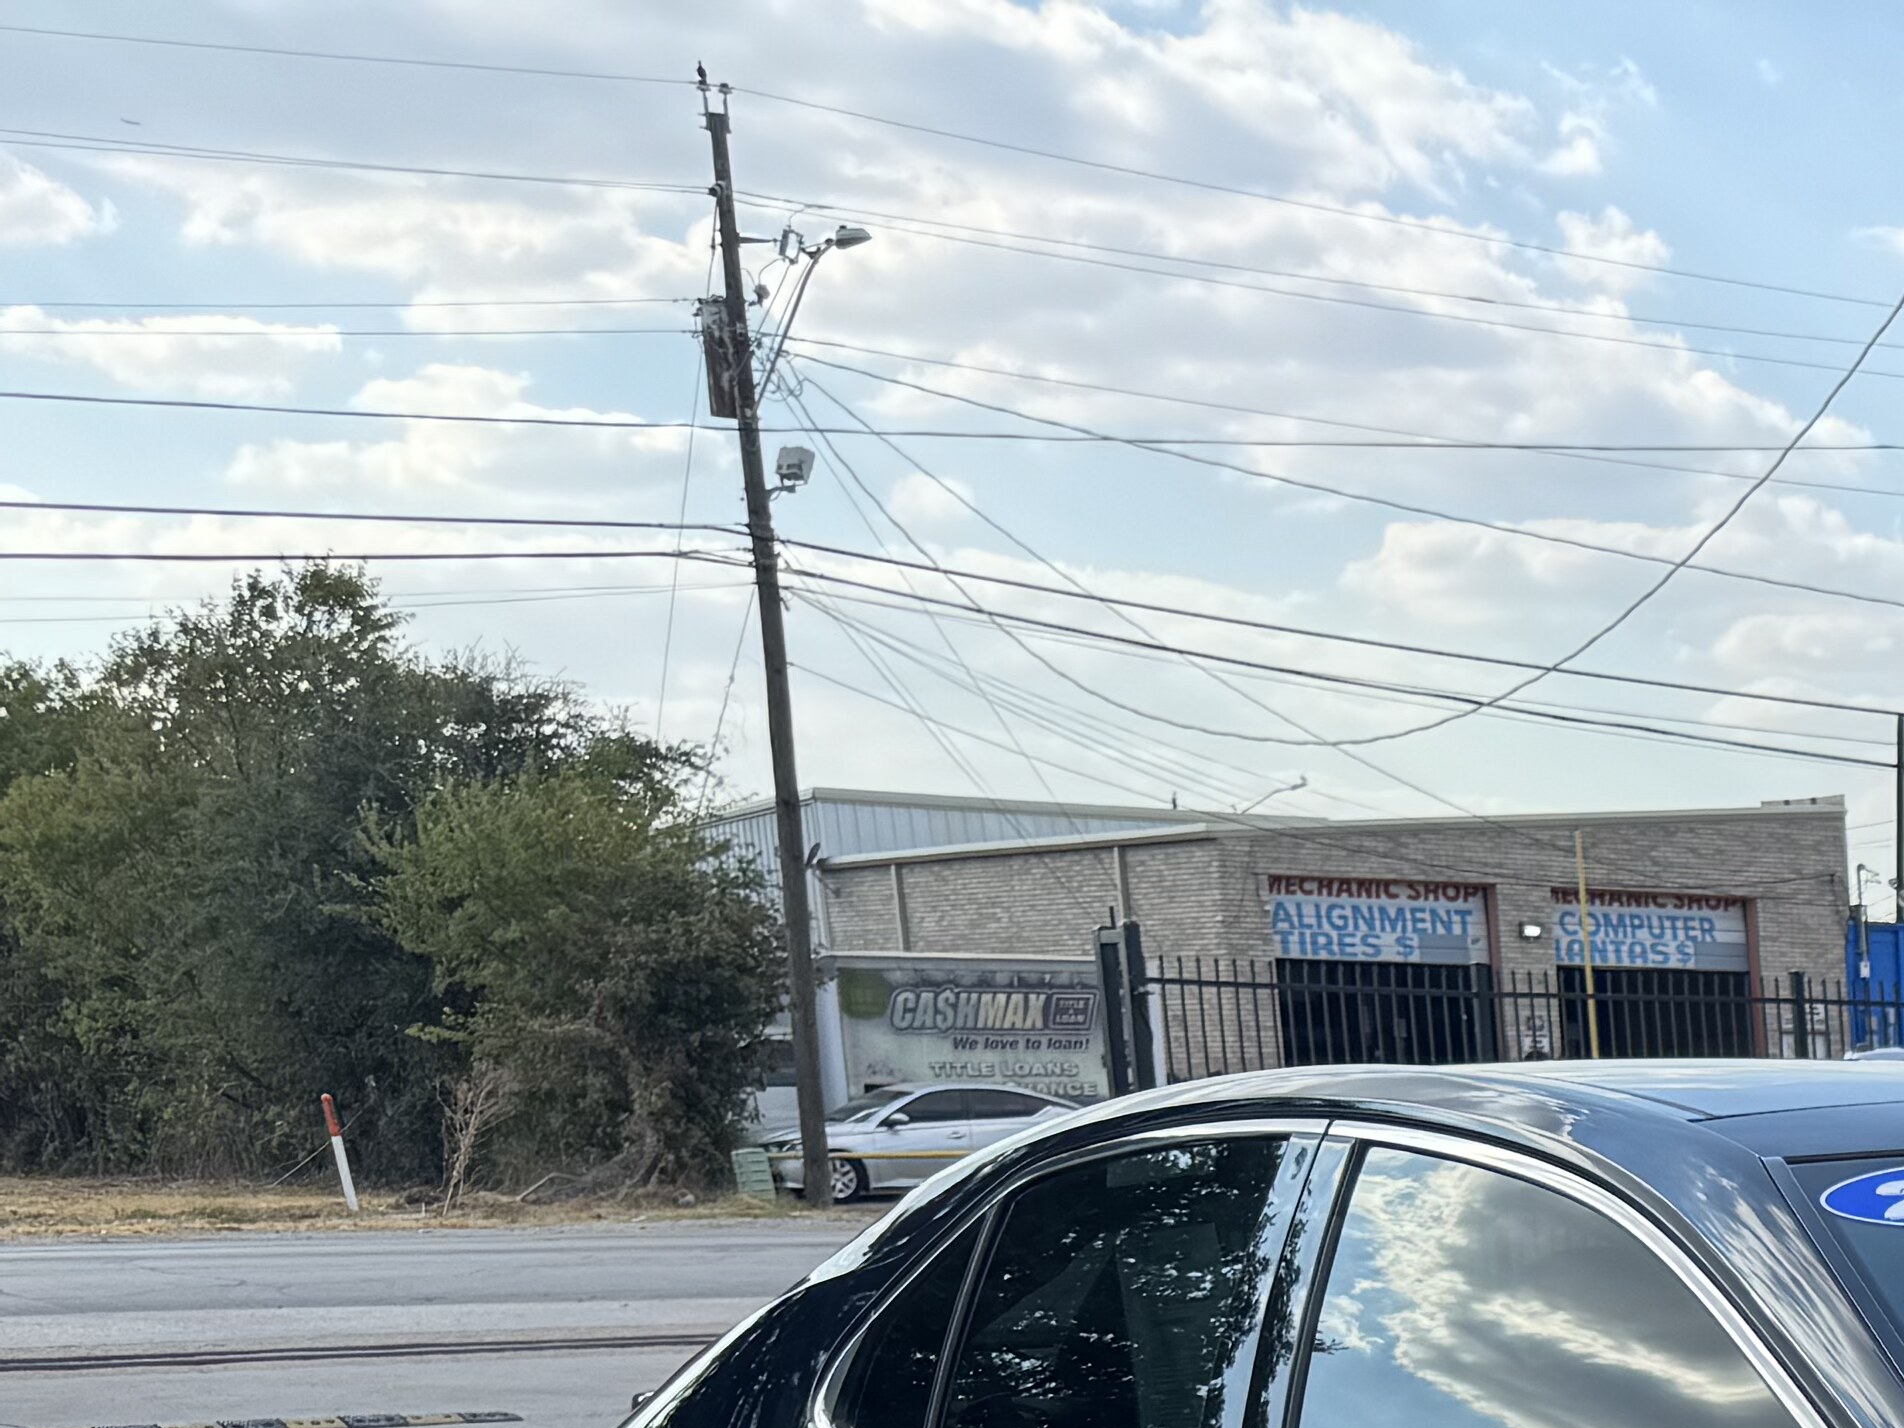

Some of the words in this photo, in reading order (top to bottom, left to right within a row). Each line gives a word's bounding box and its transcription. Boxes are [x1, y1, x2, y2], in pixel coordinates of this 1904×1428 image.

[1407, 883, 1480, 903] SHOP
[1271, 901, 1473, 936] ALIGNMENT
[1558, 911, 1717, 943] COMPUTER
[1272, 930, 1382, 959] TIRES
[893, 989, 1048, 1031] CA$HMAX
[953, 1036, 978, 1050] We
[983, 1036, 1018, 1050] love
[1025, 1037, 1041, 1050] to
[1047, 1036, 1090, 1051] loan!
[929, 1061, 996, 1078] TITLE
[1002, 1062, 1079, 1078] LOANS
